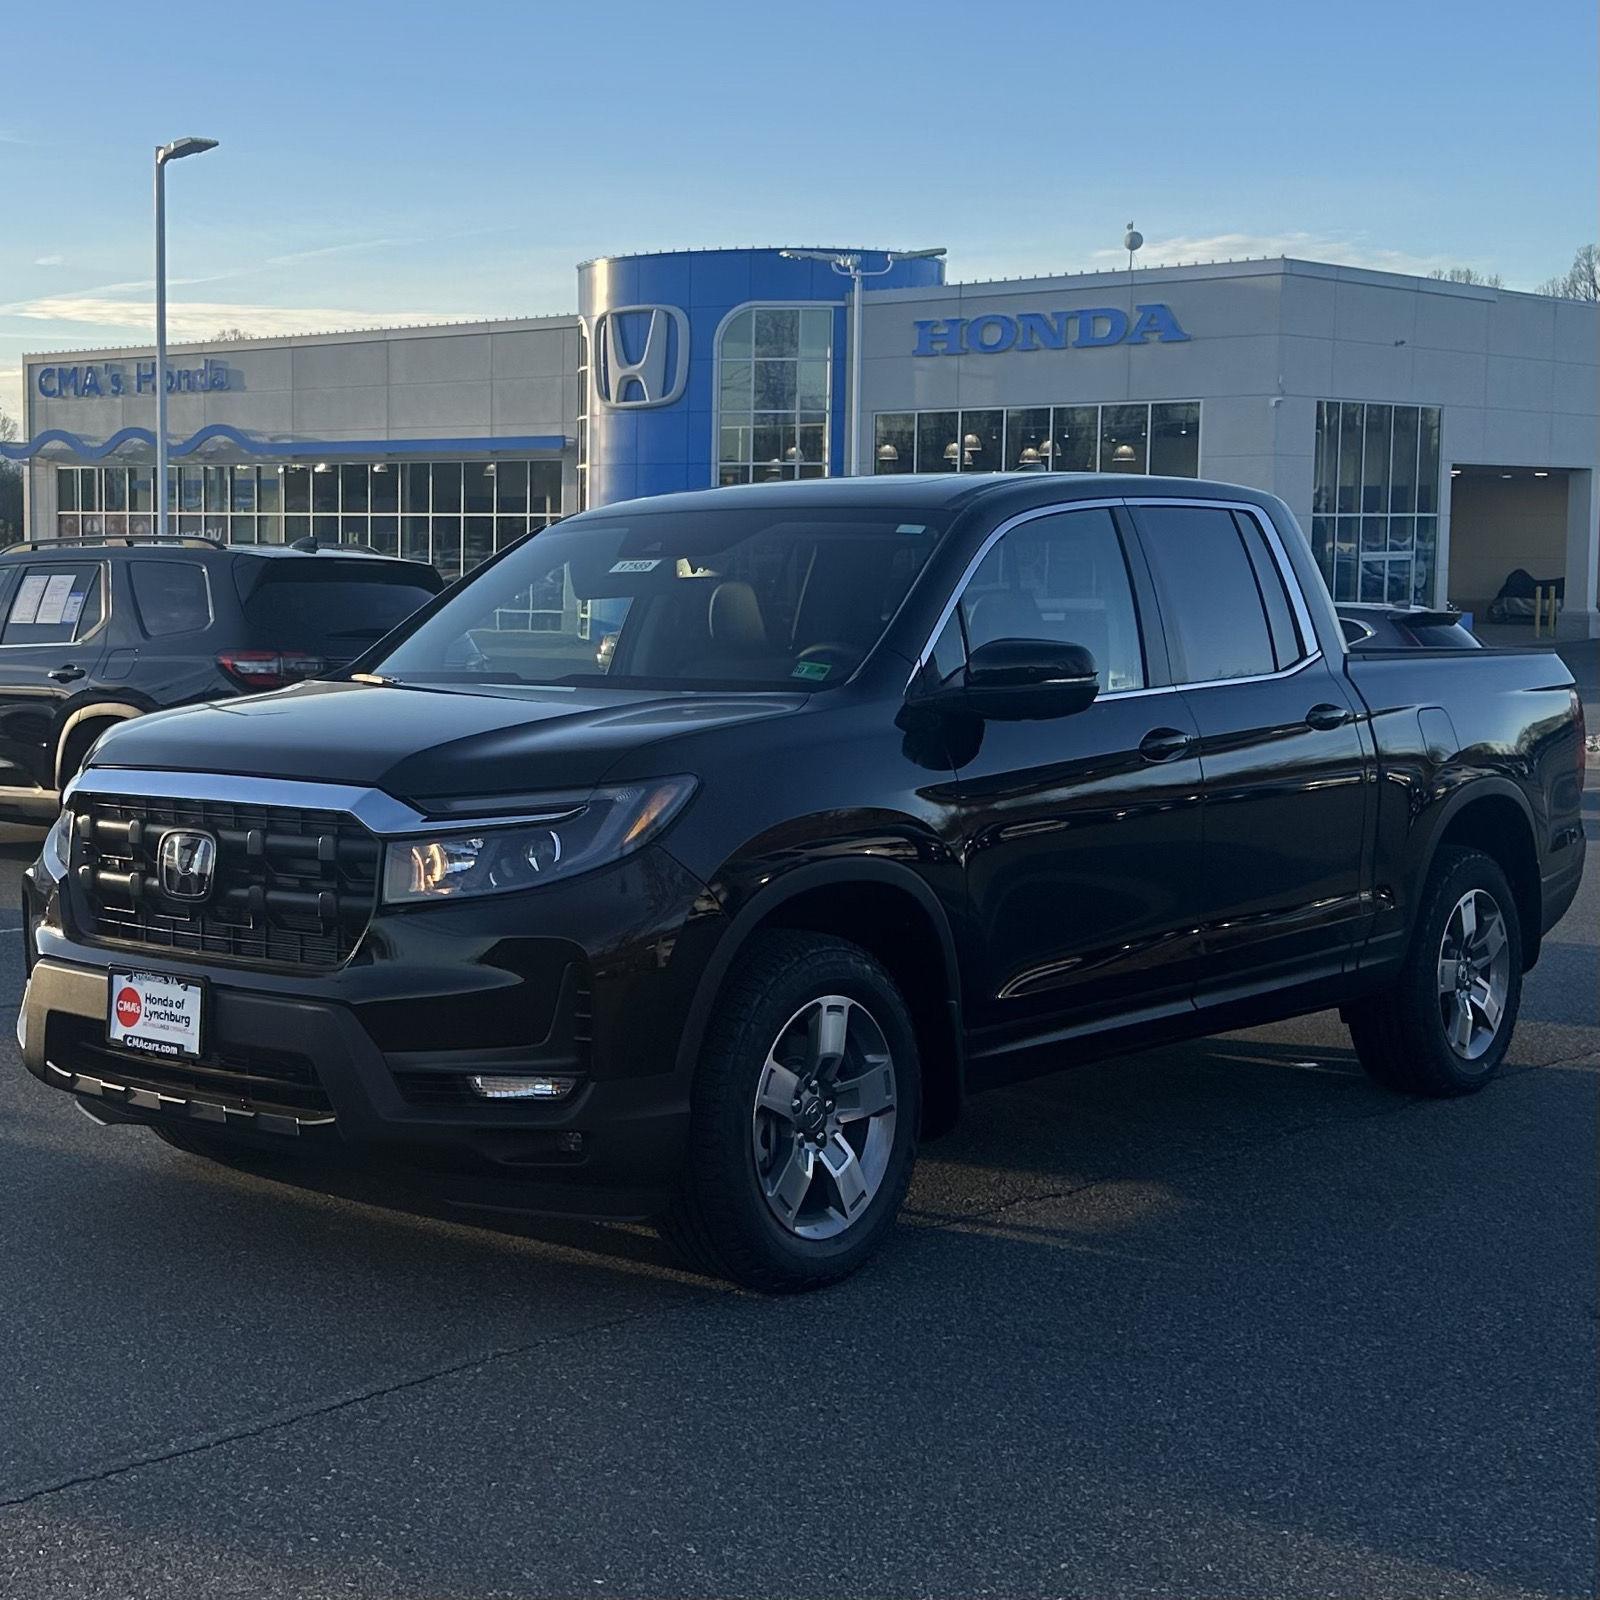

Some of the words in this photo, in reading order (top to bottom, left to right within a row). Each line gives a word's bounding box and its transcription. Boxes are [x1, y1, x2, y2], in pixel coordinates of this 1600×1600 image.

[912, 303, 1191, 356] HONDA
[38, 363, 125, 398] CMA's
[145, 993, 173, 1008] Honda
[175, 998, 185, 1010] of
[144, 1008, 191, 1027] Lynchburg
[126, 1037, 178, 1054] CMAcars.com
